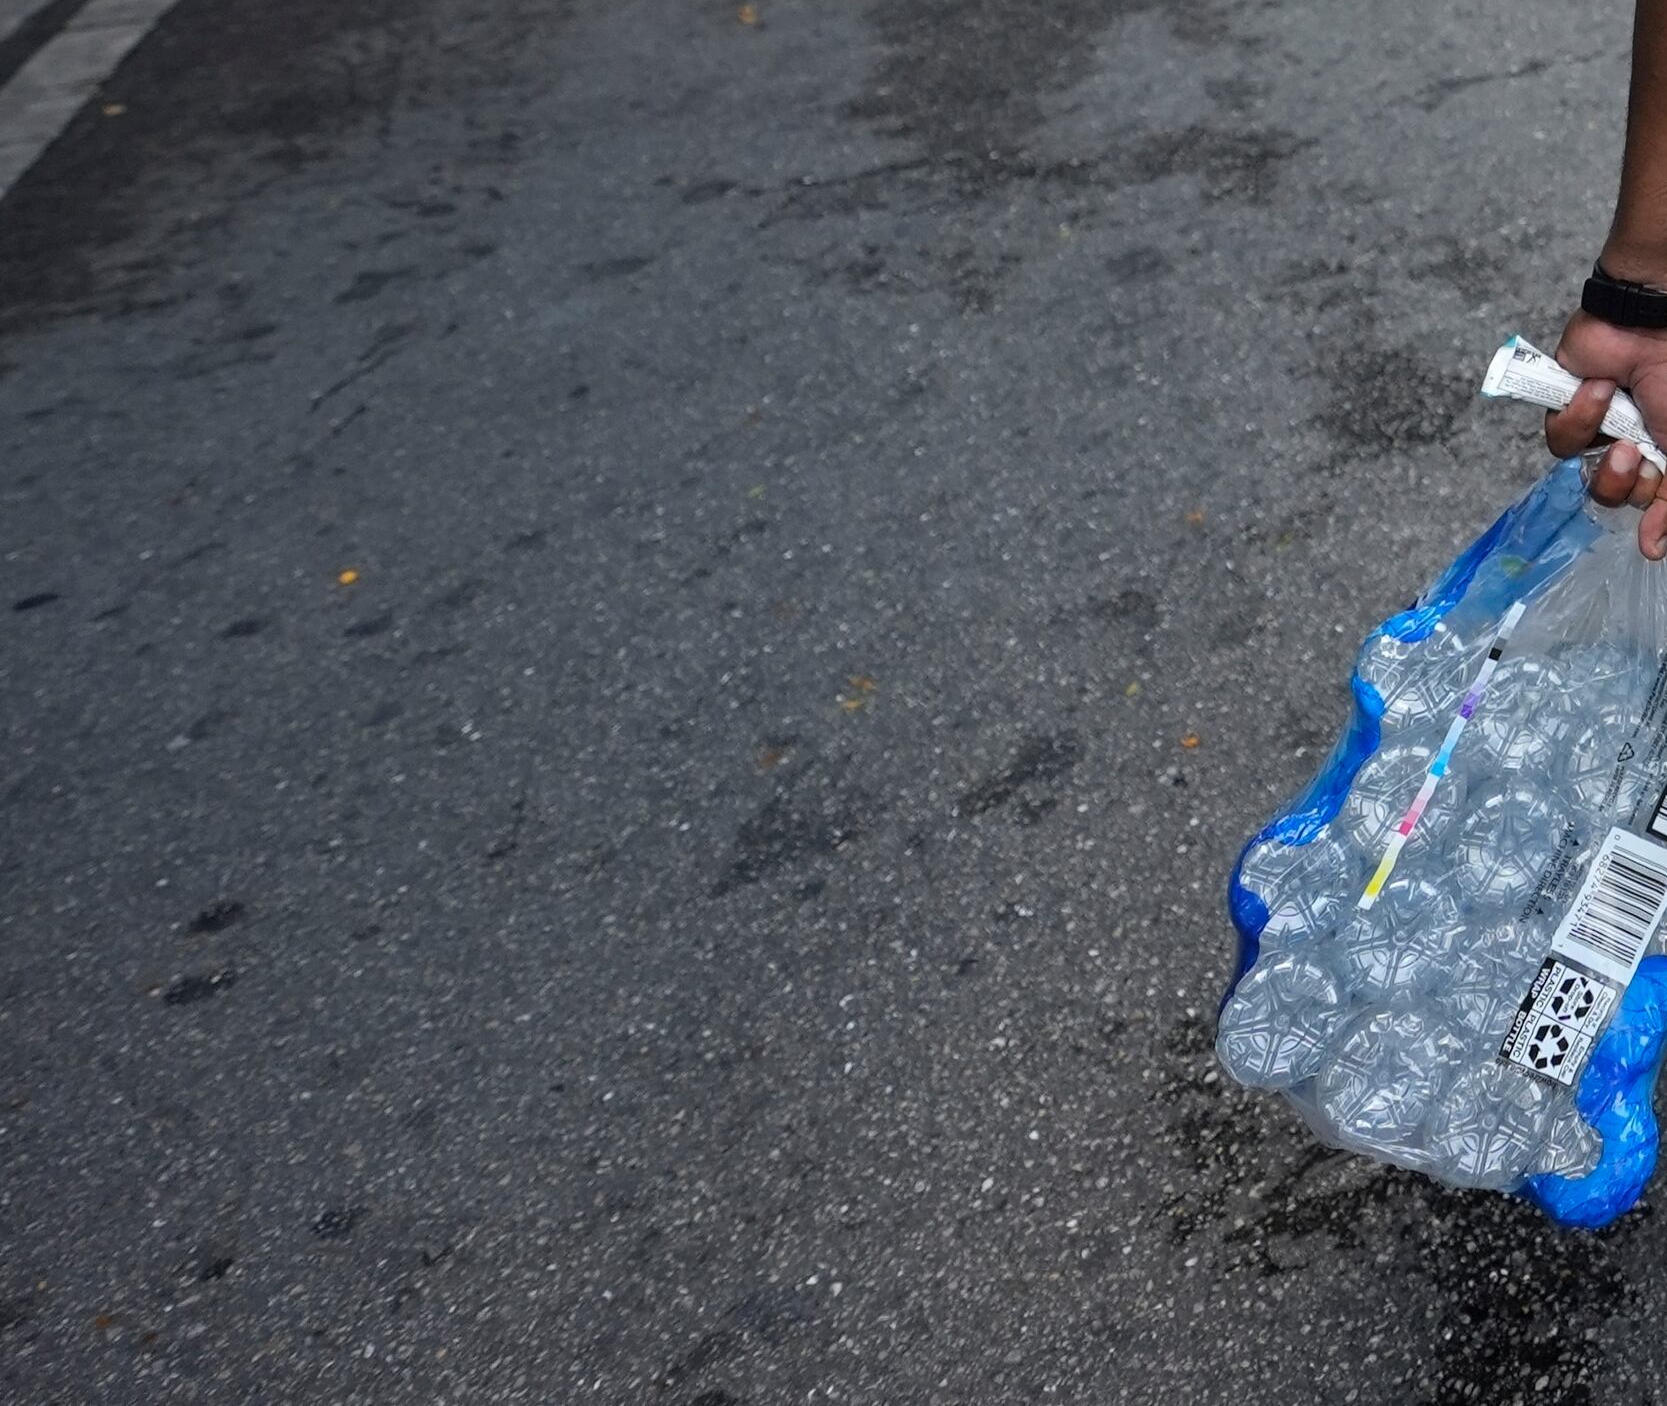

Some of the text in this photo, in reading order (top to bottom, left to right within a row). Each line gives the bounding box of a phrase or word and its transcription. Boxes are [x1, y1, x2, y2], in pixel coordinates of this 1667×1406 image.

[1545, 820, 1577, 870] MACHINE
[1541, 852, 1572, 902] TRAYLESS
[1587, 852, 1612, 891] 68274
[1517, 867, 1552, 925] DIRECTION
[1569, 892, 1593, 928] 93471
[1528, 966, 1549, 998] WRAP
[1533, 964, 1562, 1009] PLASTIC
[1500, 1009, 1528, 1054] BOTTLE
[1509, 1012, 1538, 1058] PLASTIC
